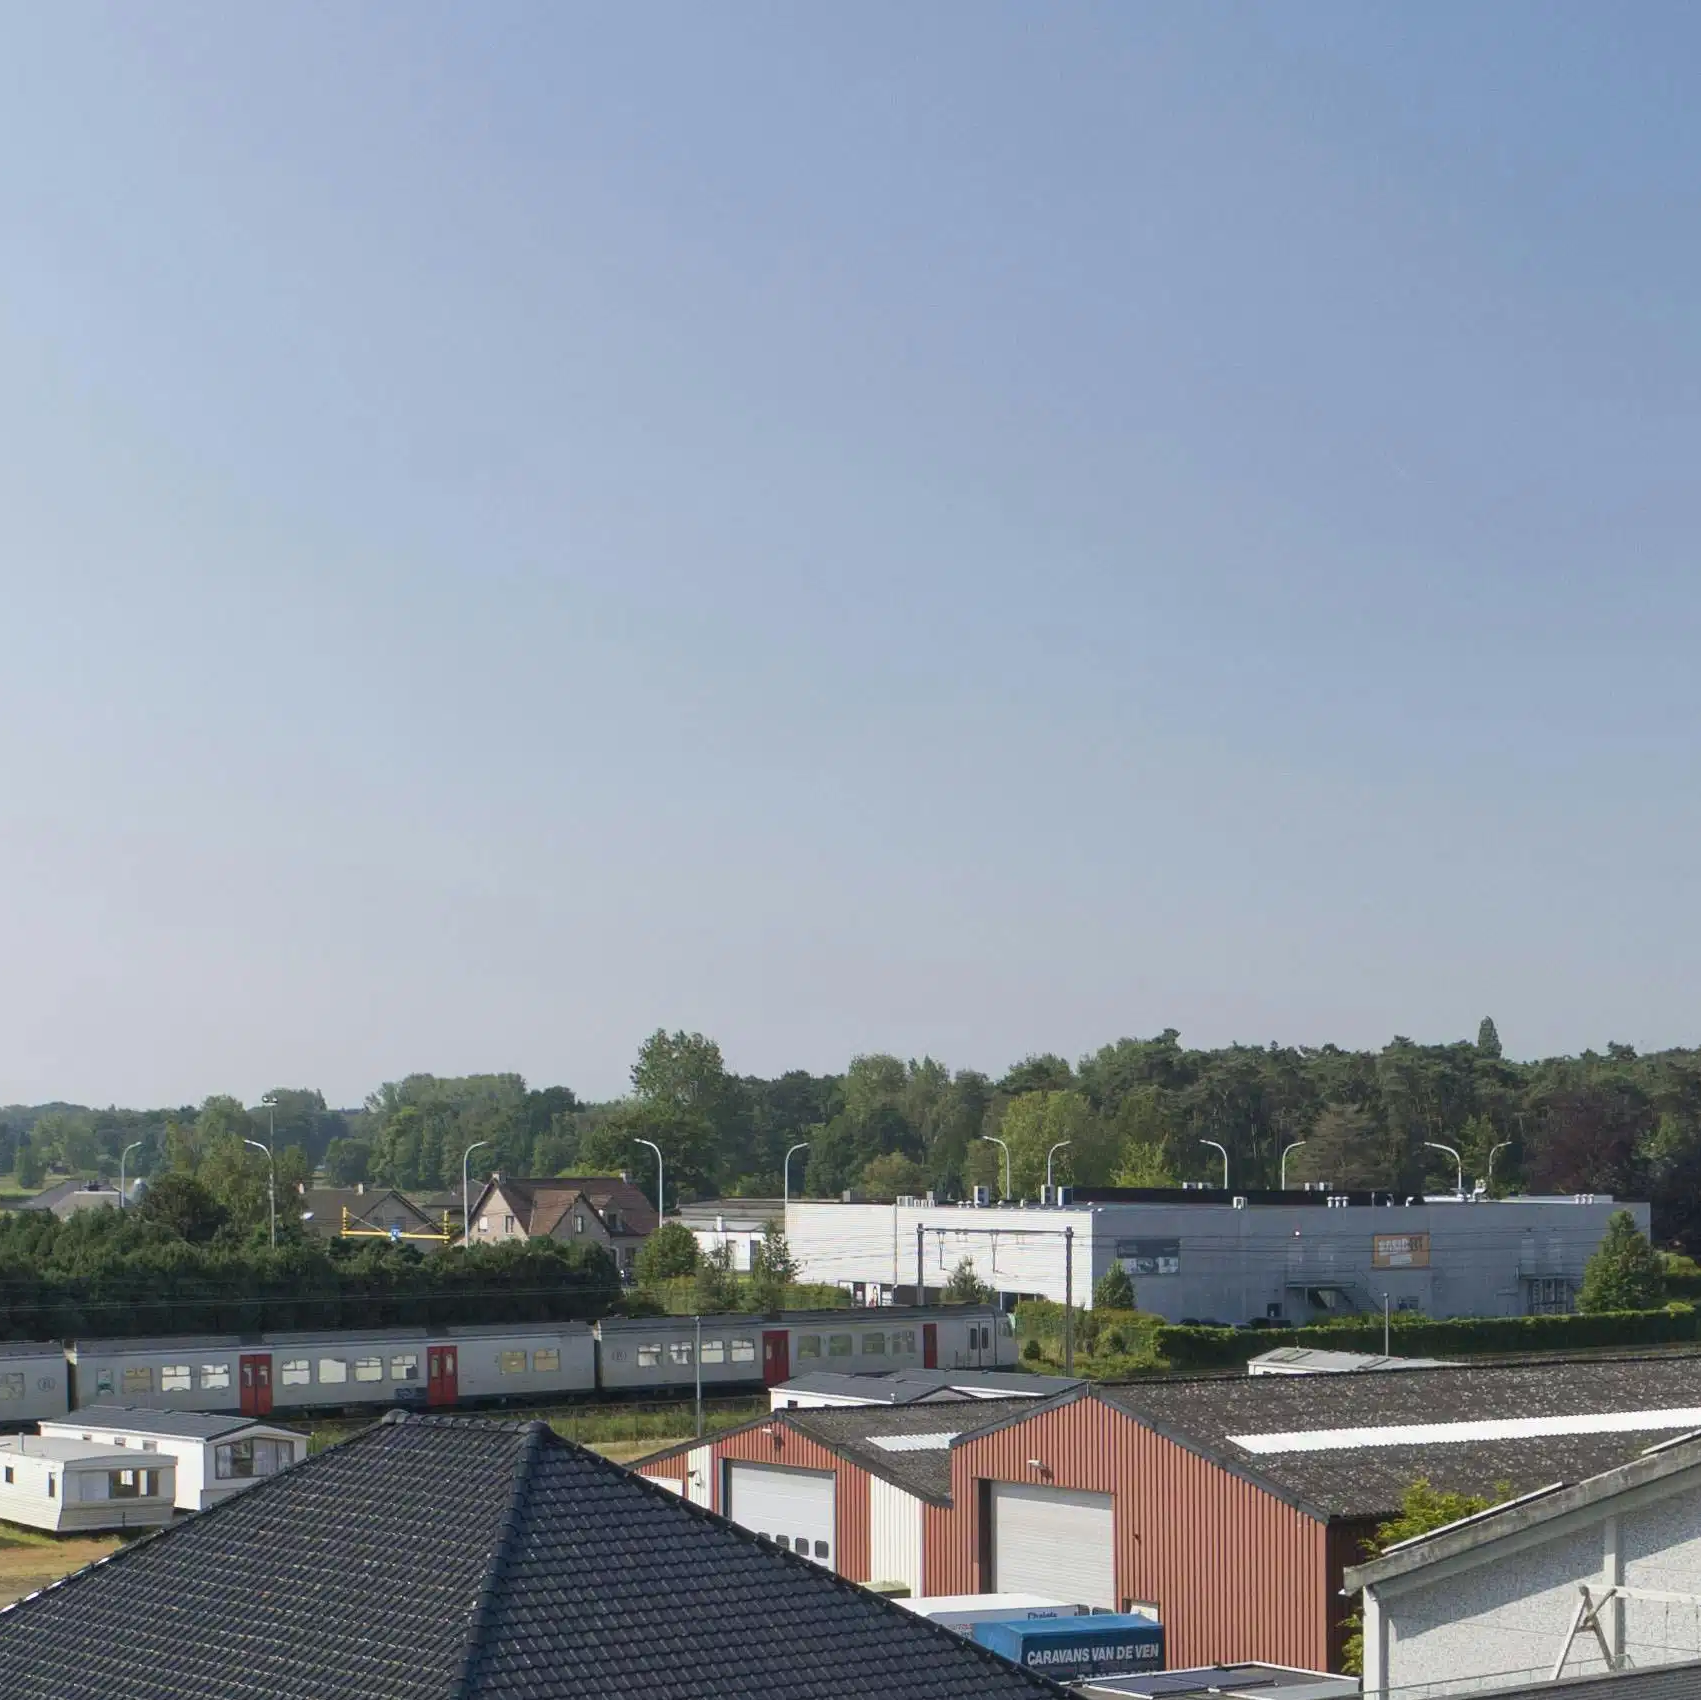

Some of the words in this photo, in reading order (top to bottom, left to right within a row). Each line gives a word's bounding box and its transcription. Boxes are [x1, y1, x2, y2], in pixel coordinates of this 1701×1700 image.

[1027, 1647, 1090, 1665] CARAVANS
[1091, 1645, 1115, 1661] VAN
[1116, 1644, 1134, 1660] DE
[1135, 1642, 1159, 1658] VEN
